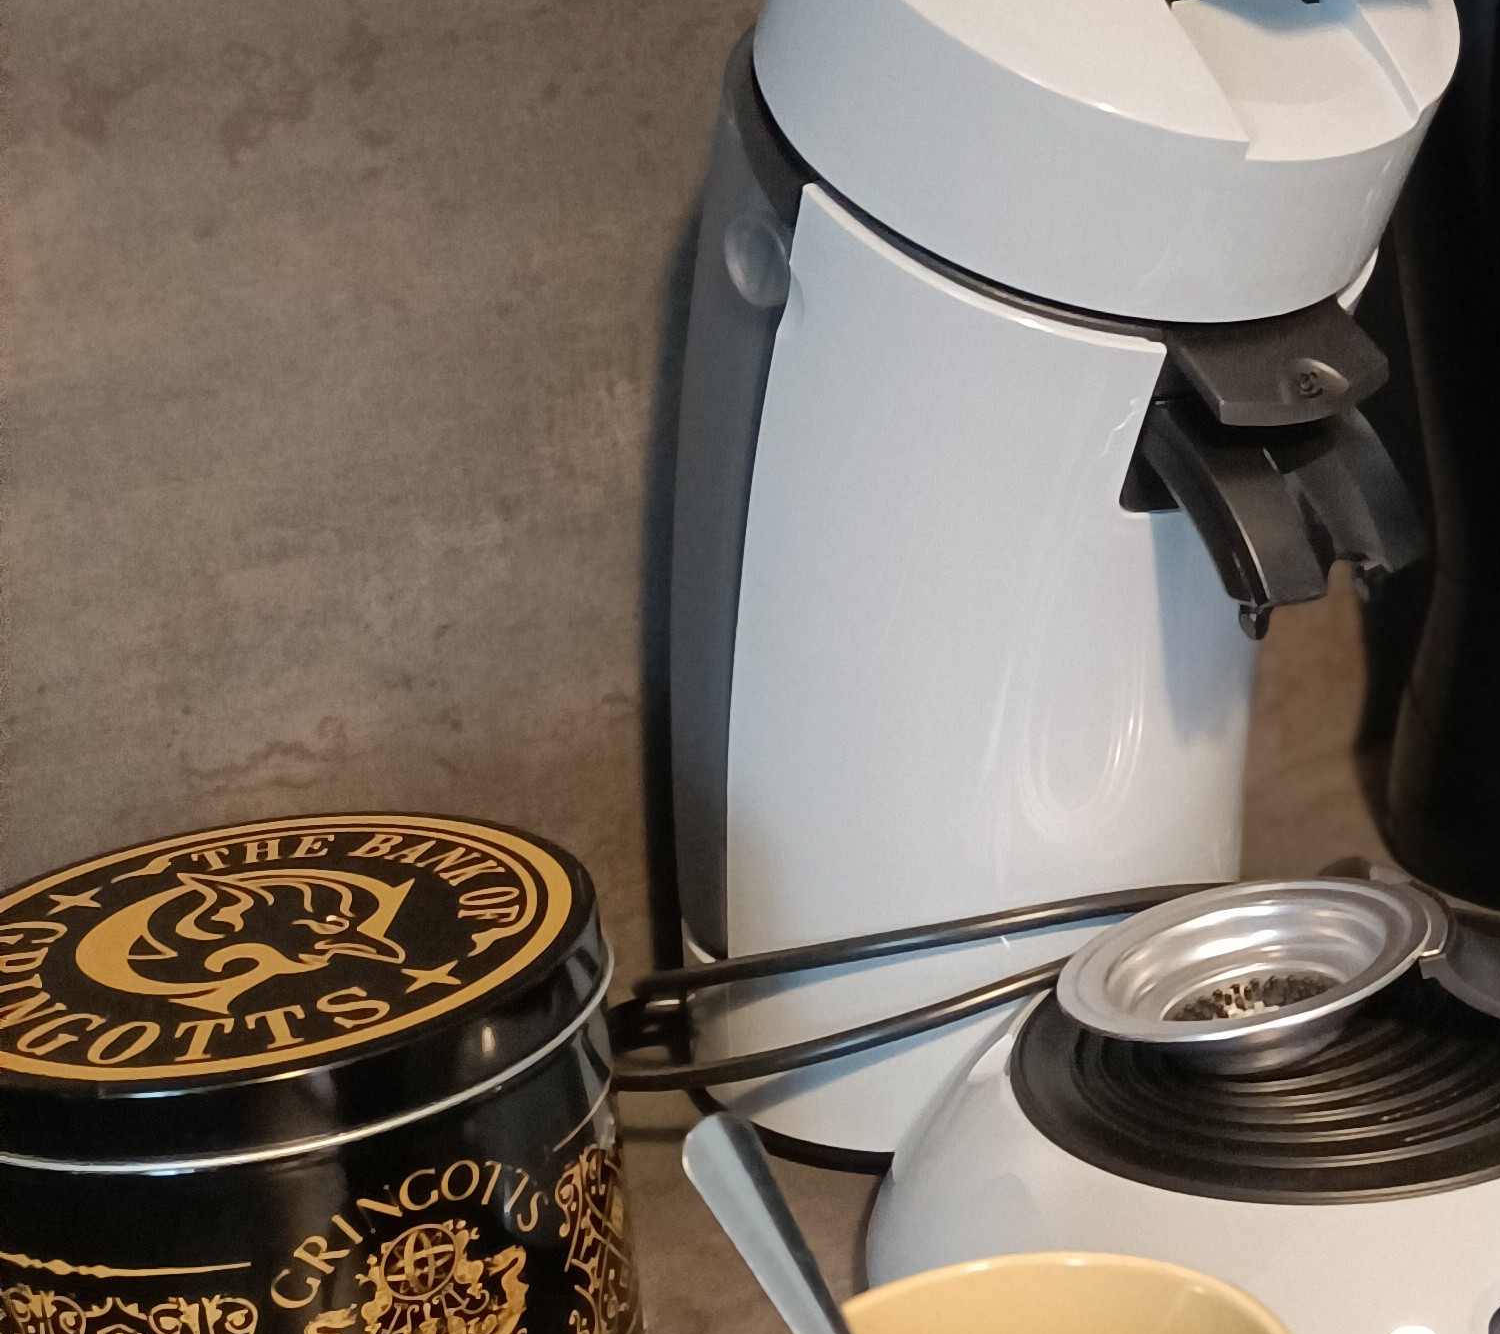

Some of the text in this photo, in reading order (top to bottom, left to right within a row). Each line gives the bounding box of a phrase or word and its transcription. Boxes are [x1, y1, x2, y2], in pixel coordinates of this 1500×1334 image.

[191, 833, 519, 924] THE BANK OF
[270, 1159, 549, 1309] GRINGOTTS
